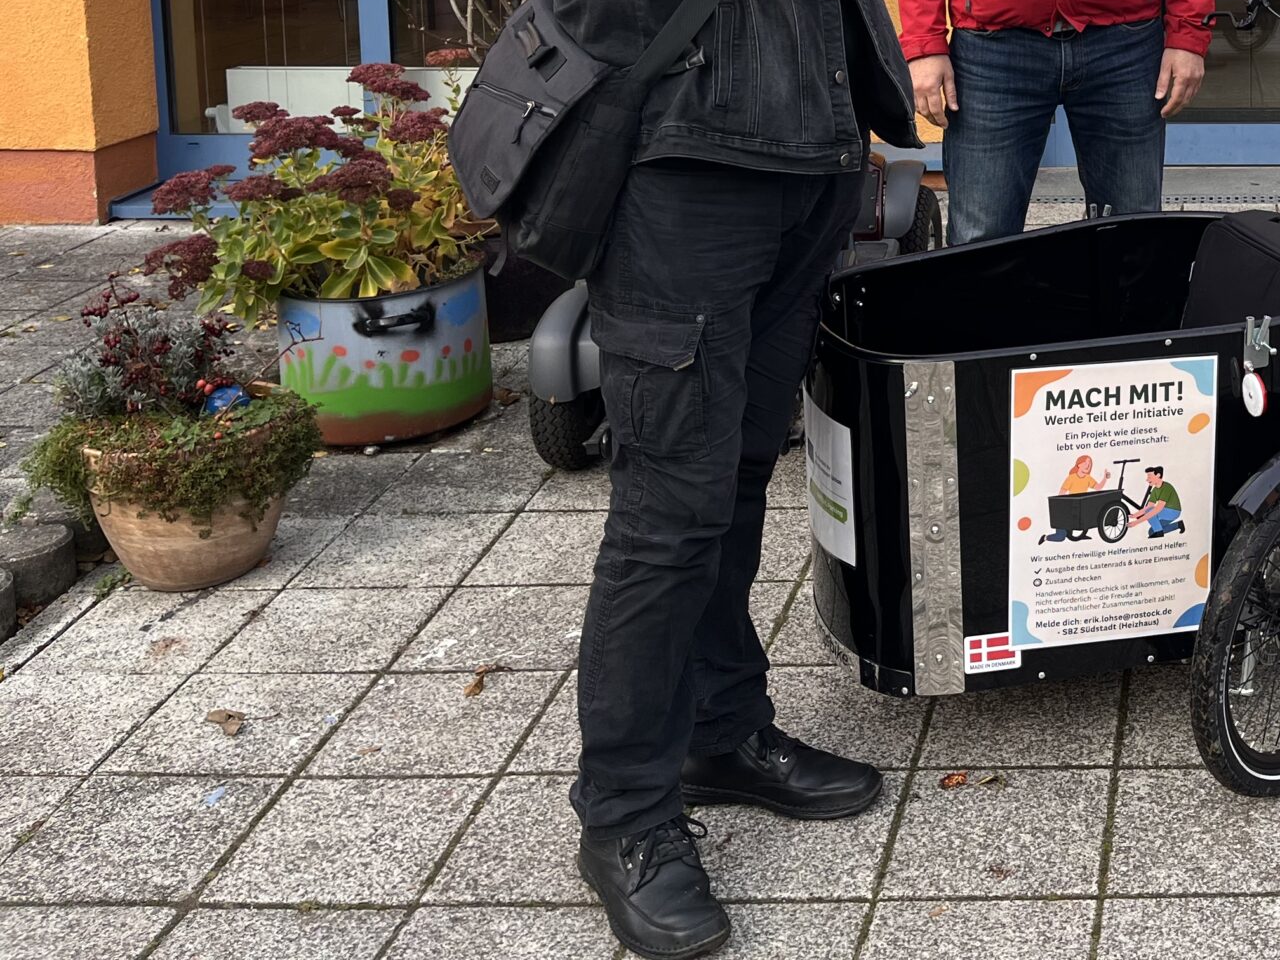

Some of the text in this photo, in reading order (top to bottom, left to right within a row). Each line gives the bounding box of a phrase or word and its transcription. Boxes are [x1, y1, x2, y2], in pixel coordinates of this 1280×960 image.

[1045, 381, 1183, 410] MACH MIT!
[1045, 406, 1184, 426] Werde Teil der Initiative
[1065, 426, 1158, 441] Ein Projekt wie dieses
[1056, 443, 1074, 452] lebt
[1093, 439, 1107, 449] der
[1109, 435, 1170, 447] Gemeinschaft:
[1030, 555, 1043, 563] Wir
[1044, 552, 1071, 562] suchen
[1072, 550, 1106, 560] freiwillige
[1107, 545, 1148, 557] Helferinnen
[1149, 543, 1163, 552] und
[1045, 552, 1190, 575] Ausgabe des Lastenrads & kurze Einweisung
[1045, 574, 1102, 586] Zustand checken
[1089, 584, 1119, 594] Geschick
[1120, 583, 1128, 591] ist
[1171, 577, 1187, 585] aber
[1035, 598, 1053, 607] nicht
[1053, 595, 1092, 606] erforderlich
[1099, 592, 1109, 601] die
[1110, 590, 1133, 601] Freude
[1035, 604, 1101, 615] nachbarschaftlicher
[1101, 597, 1157, 609] Zusammenarbeit
[1035, 619, 1061, 629] Melde
[1062, 617, 1082, 627] dich:
[1062, 627, 1079, 636] SBZ
[1080, 622, 1117, 634] Südstadt
[1118, 618, 1160, 631] (Heizhaus)
